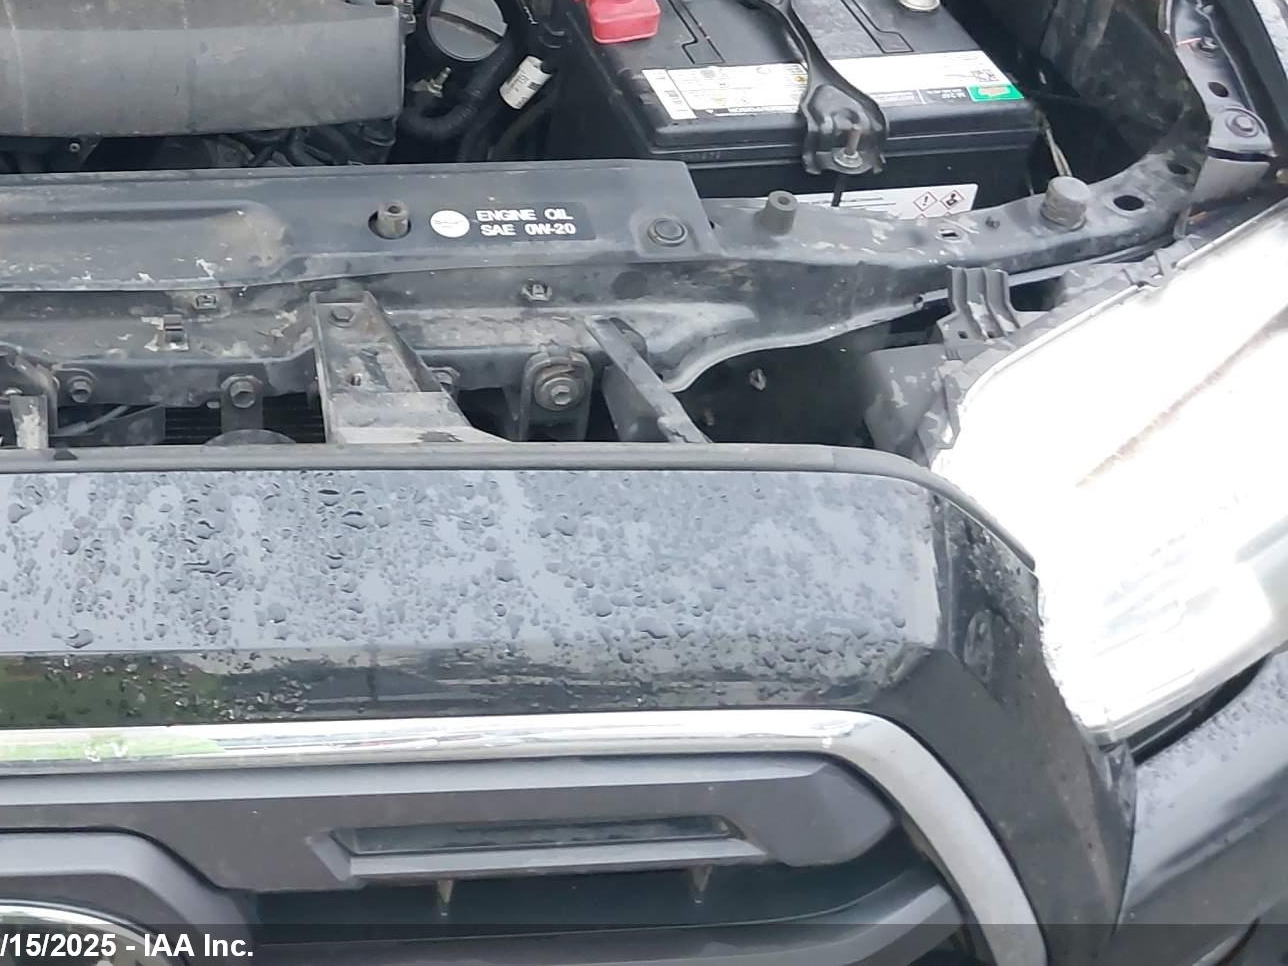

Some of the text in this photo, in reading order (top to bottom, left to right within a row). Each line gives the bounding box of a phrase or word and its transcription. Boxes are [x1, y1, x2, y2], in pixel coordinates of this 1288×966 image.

[475, 208, 574, 222] ENGINE OIL
[480, 223, 577, 236] SAE 0W-20
